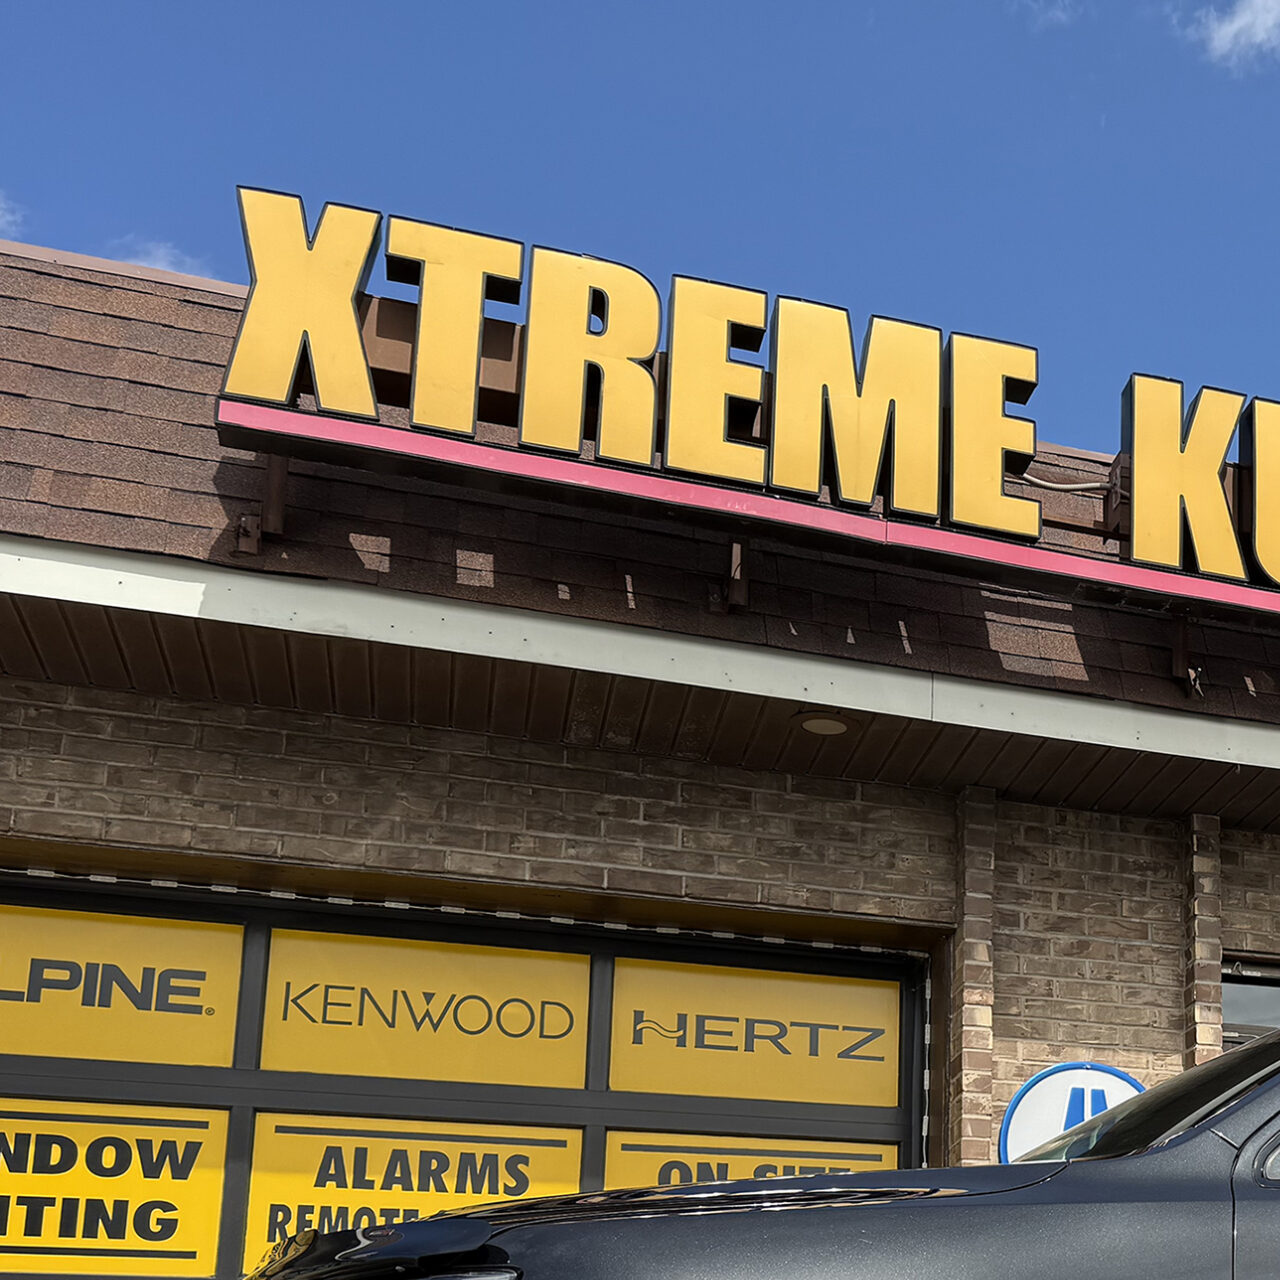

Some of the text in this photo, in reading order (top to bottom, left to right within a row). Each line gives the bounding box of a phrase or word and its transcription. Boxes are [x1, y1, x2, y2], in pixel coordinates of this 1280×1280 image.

[219, 185, 1043, 542] XTREME
[281, 981, 575, 1040] KENWOOD
[631, 1009, 886, 1062] HERTZ
[313, 1145, 531, 1197] ALARMS
